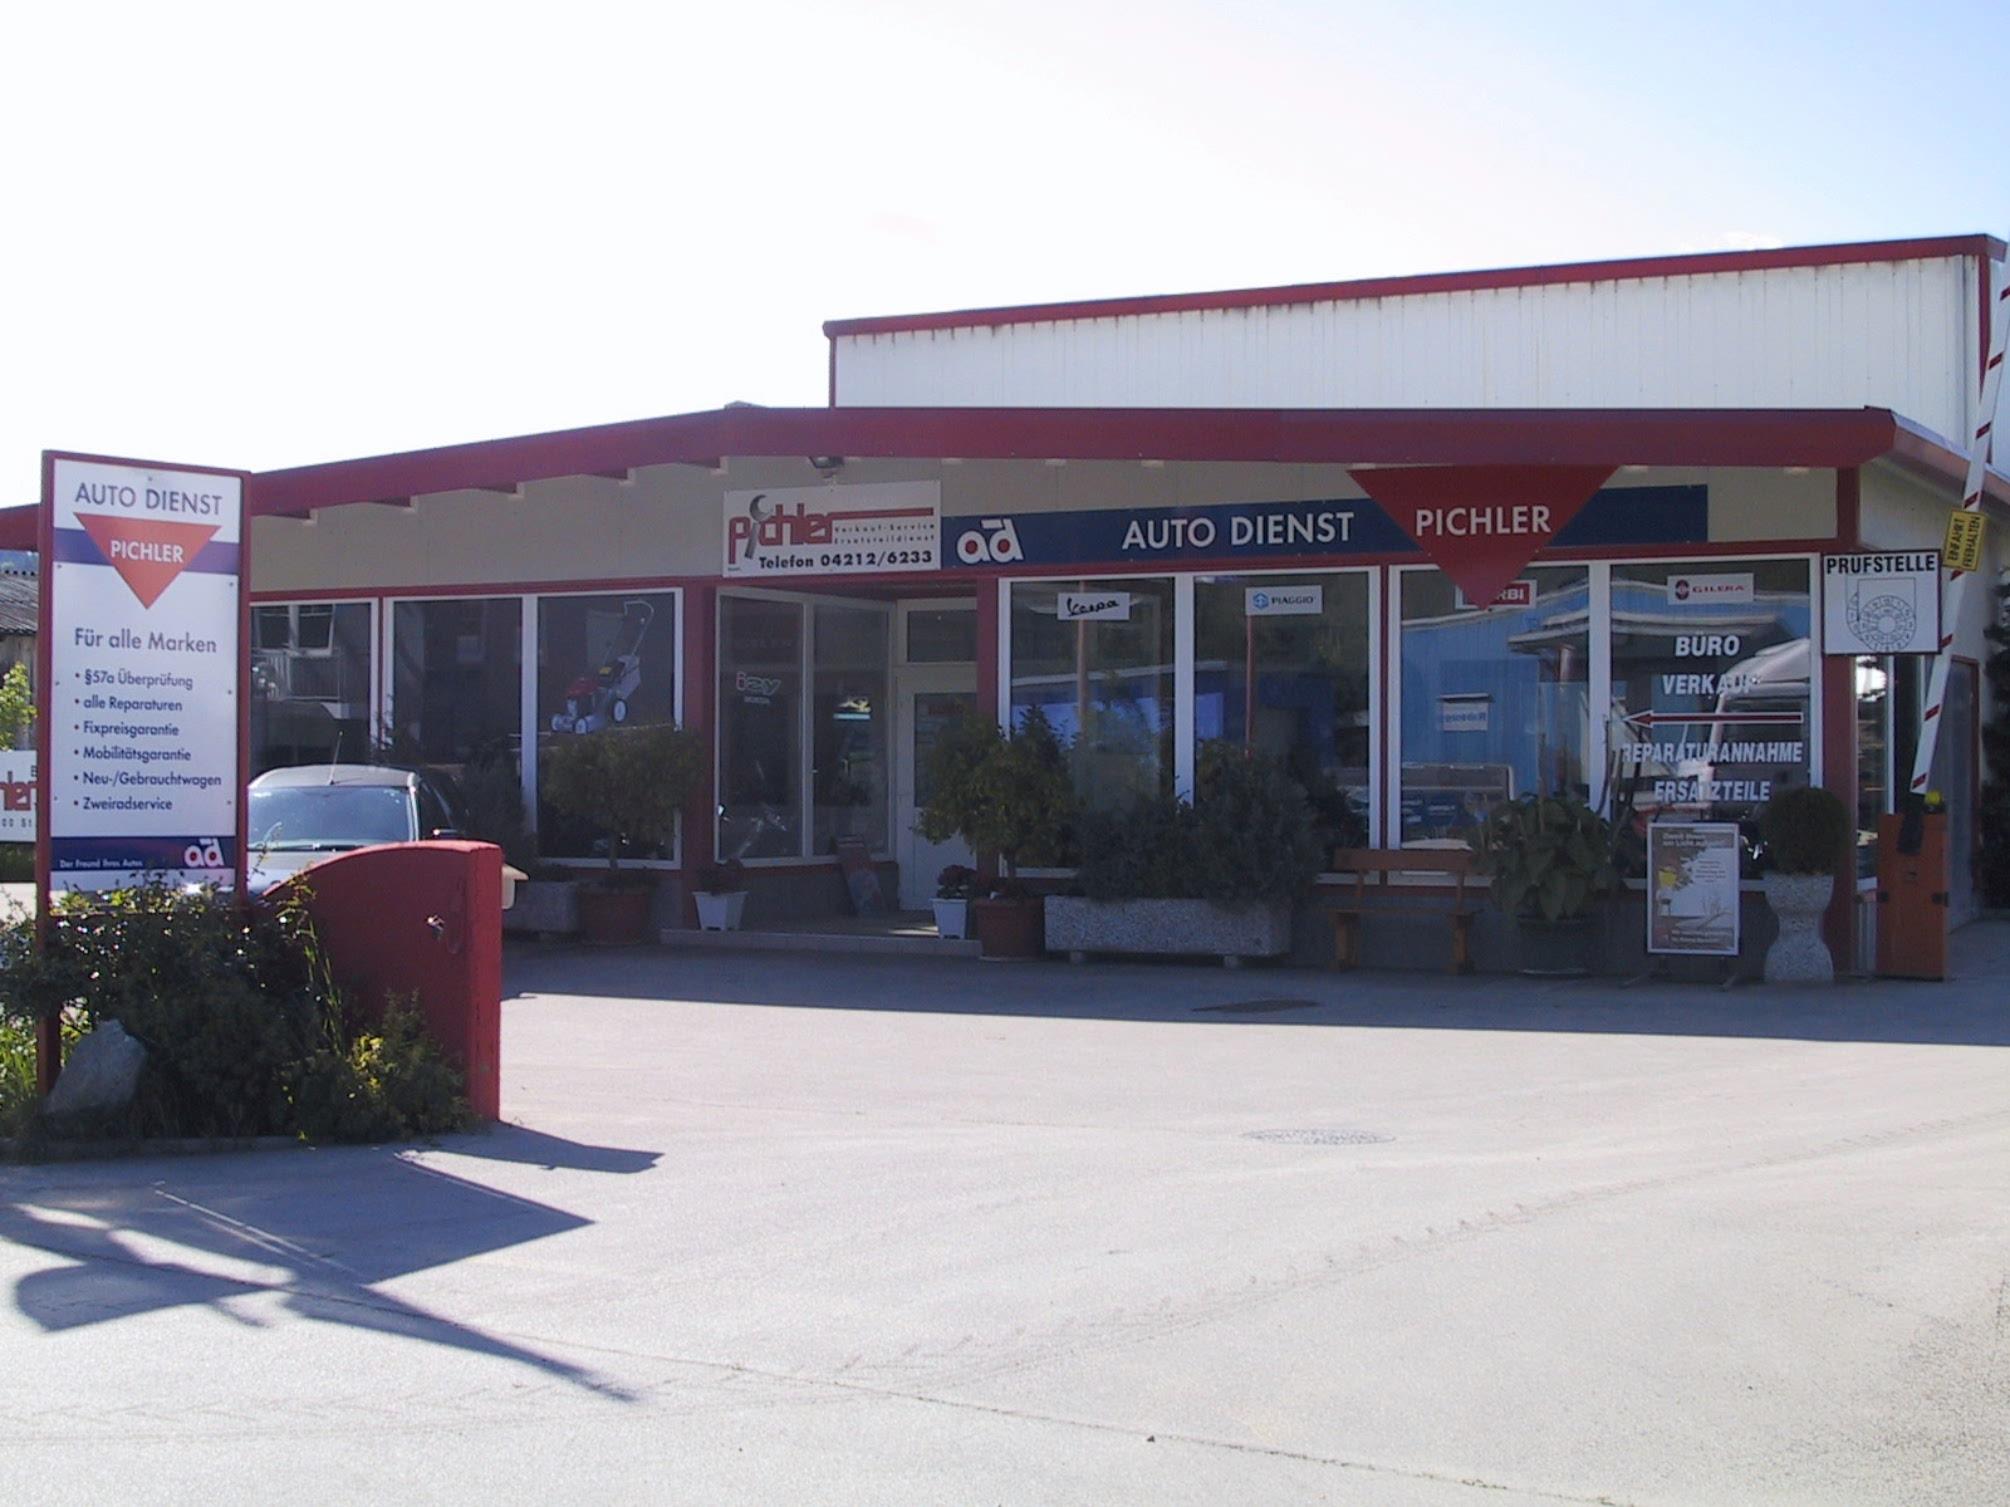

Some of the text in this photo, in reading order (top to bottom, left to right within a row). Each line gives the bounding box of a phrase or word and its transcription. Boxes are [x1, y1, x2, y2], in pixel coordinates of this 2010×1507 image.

[75, 482, 223, 516] AUTO DIENST
[1122, 511, 1354, 551] AUTO DIENST
[1415, 505, 1551, 537] PICHLER
[110, 540, 184, 564] PICHLER
[758, 550, 932, 569] Telefon 04212/6233
[1692, 584, 1745, 593] GILERA
[1066, 597, 1120, 617] Vespa
[1271, 596, 1314, 605] PIAGGIO
[75, 627, 217, 654] Für alle Marken
[1675, 631, 1740, 658] BÜRO
[84, 668, 193, 691] §57a Überprüfung
[83, 694, 182, 713] alle Reparaturen
[83, 720, 180, 738] Fixpreisgarantie
[83, 745, 192, 764] Mobilitätsgarantie
[1622, 742, 1803, 763] REPARATURANNAHME
[82, 770, 222, 789] Neu-/Gebrauchtwagen
[1654, 781, 1770, 802] ERSAZTEILE
[82, 796, 173, 810] Zweiradservice
